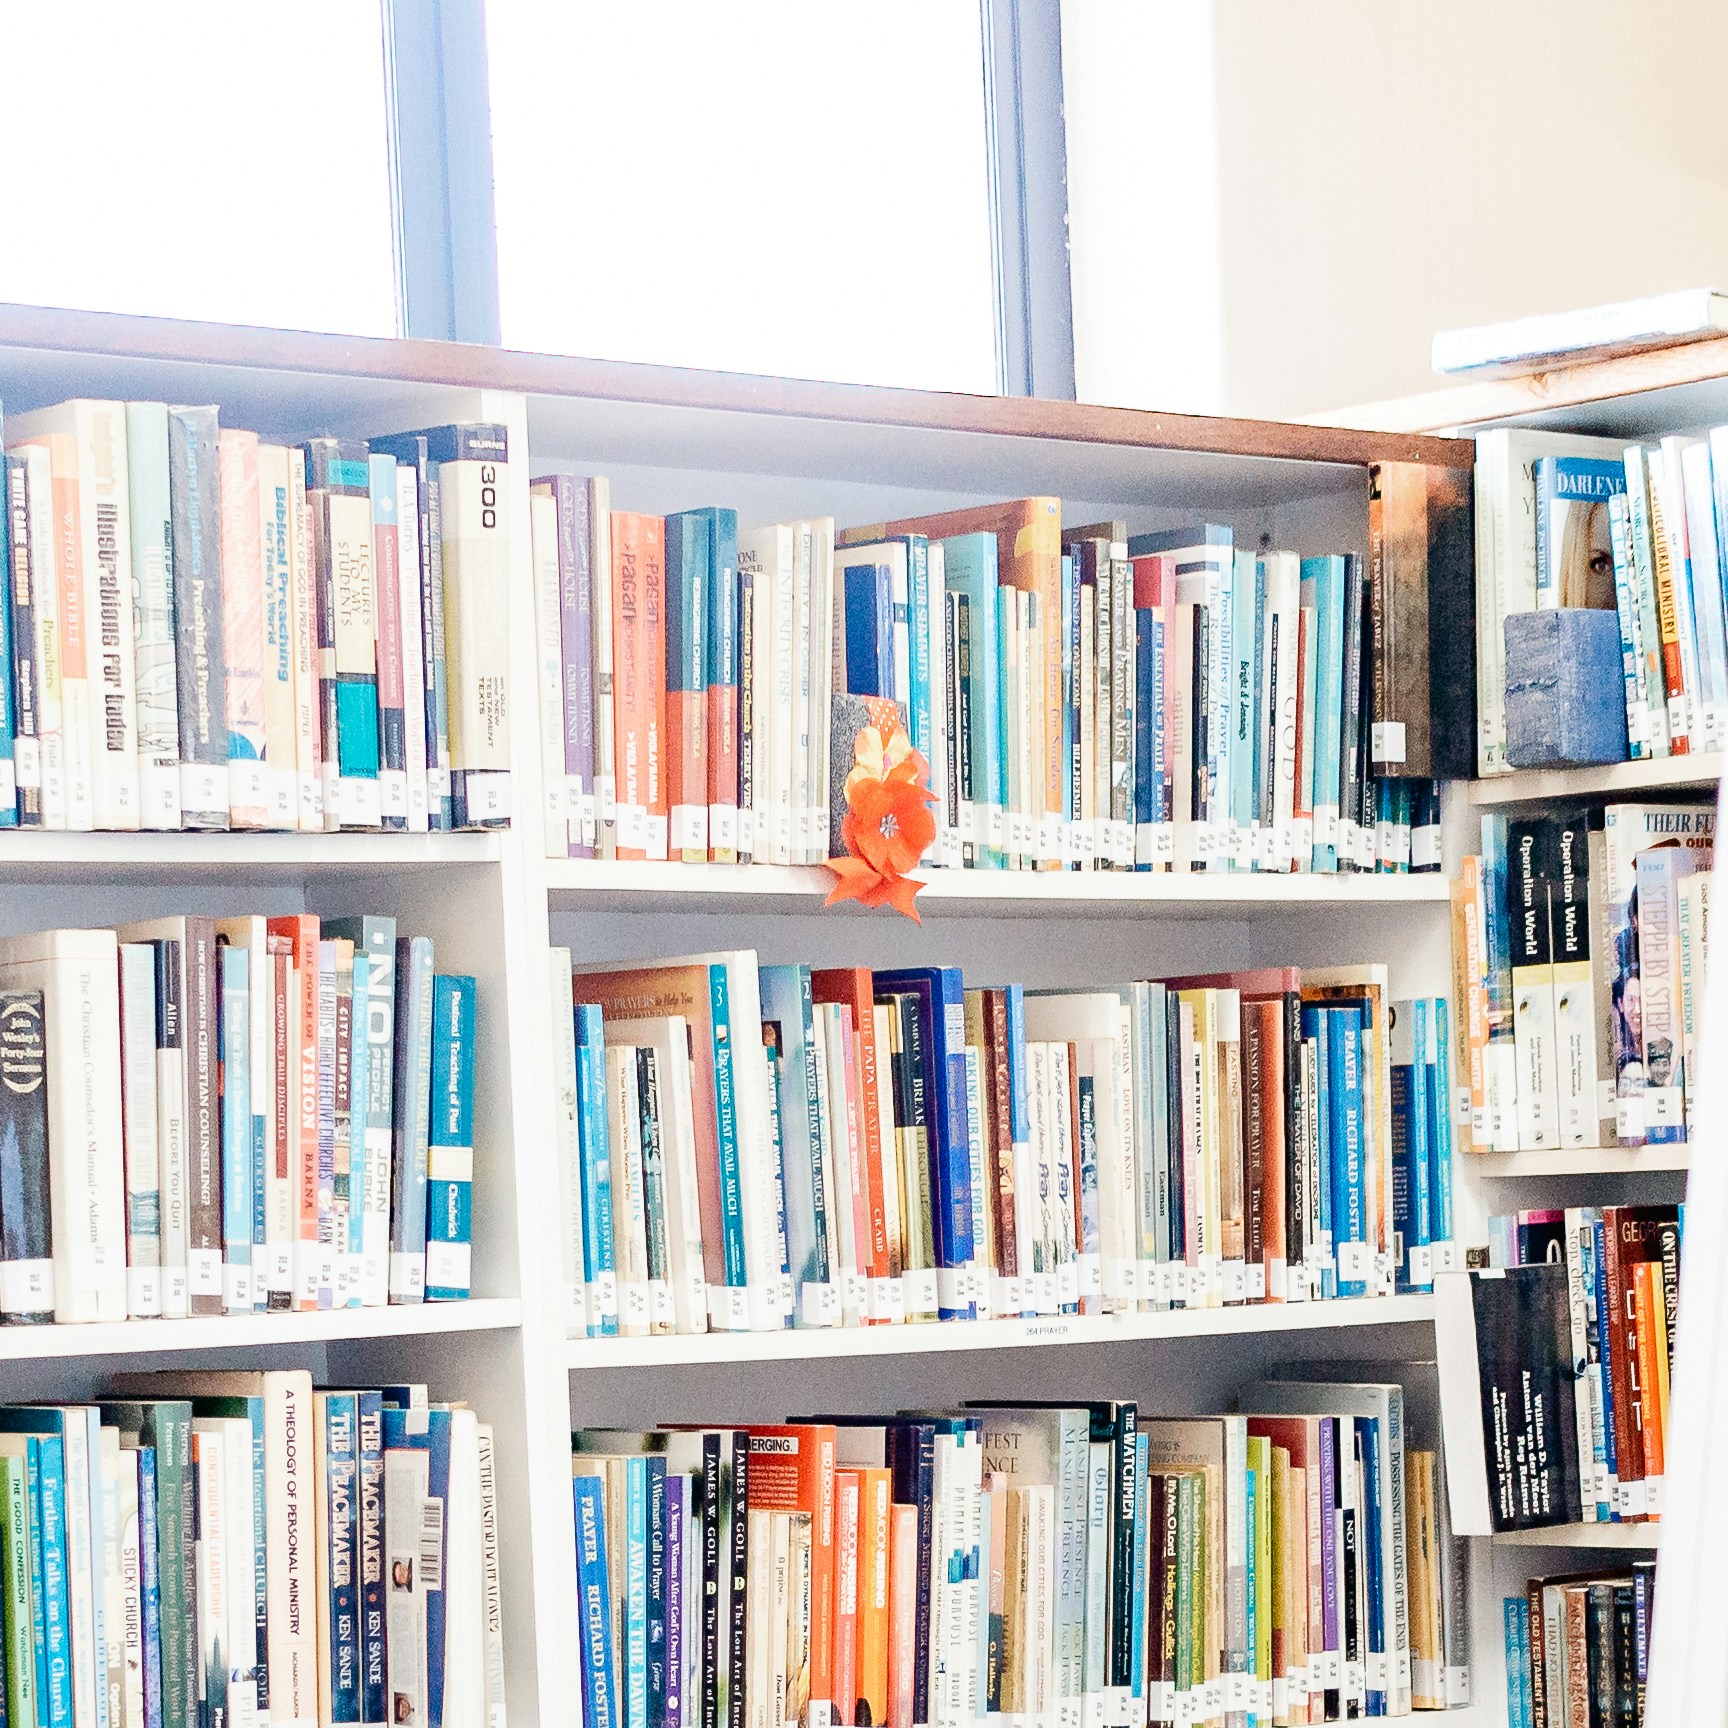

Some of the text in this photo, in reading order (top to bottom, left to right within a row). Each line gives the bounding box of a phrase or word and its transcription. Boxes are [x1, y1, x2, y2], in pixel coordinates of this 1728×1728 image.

[481, 465, 497, 529] 300
[1557, 472, 1624, 495] DARLENE
[339, 541, 352, 626] STUDENTS
[350, 558, 360, 615] TO MY
[360, 544, 372, 626] LECTURES
[1660, 566, 1676, 636] MINISTRY
[1520, 835, 1538, 957] Operation World
[1561, 829, 1579, 953] Operation World
[166, 1003, 176, 1035] Allen
[368, 954, 393, 1046] NO
[451, 991, 462, 1040] Pastoral
[301, 1046, 316, 1130] VISION
[450, 1041, 461, 1095] Teaching
[449, 1111, 459, 1135] Paul
[717, 1049, 737, 1216] PRAYERS THAT AVAIL MUCH
[1345, 1030, 1359, 1182] PRAYER RICHARD
[363, 1149, 373, 1214] BURKE
[376, 1149, 387, 1214] JOHN
[447, 1184, 457, 1238] Chadwick
[872, 1207, 883, 1252] CRABB
[1026, 1325, 1068, 1336] 264 PRAYER
[286, 1390, 300, 1635] A THEOLOGY OF PERSONAL MINISTRY
[581, 1496, 598, 1565] PRAYER
[331, 1413, 355, 1690] THE PEACEMAKER KEN SANDE
[362, 1411, 384, 1685] THE PEACEMAKER KEN SANDE
[124, 1548, 138, 1648] STICKY CHURCH
[588, 1585, 604, 1667] RICHARD
